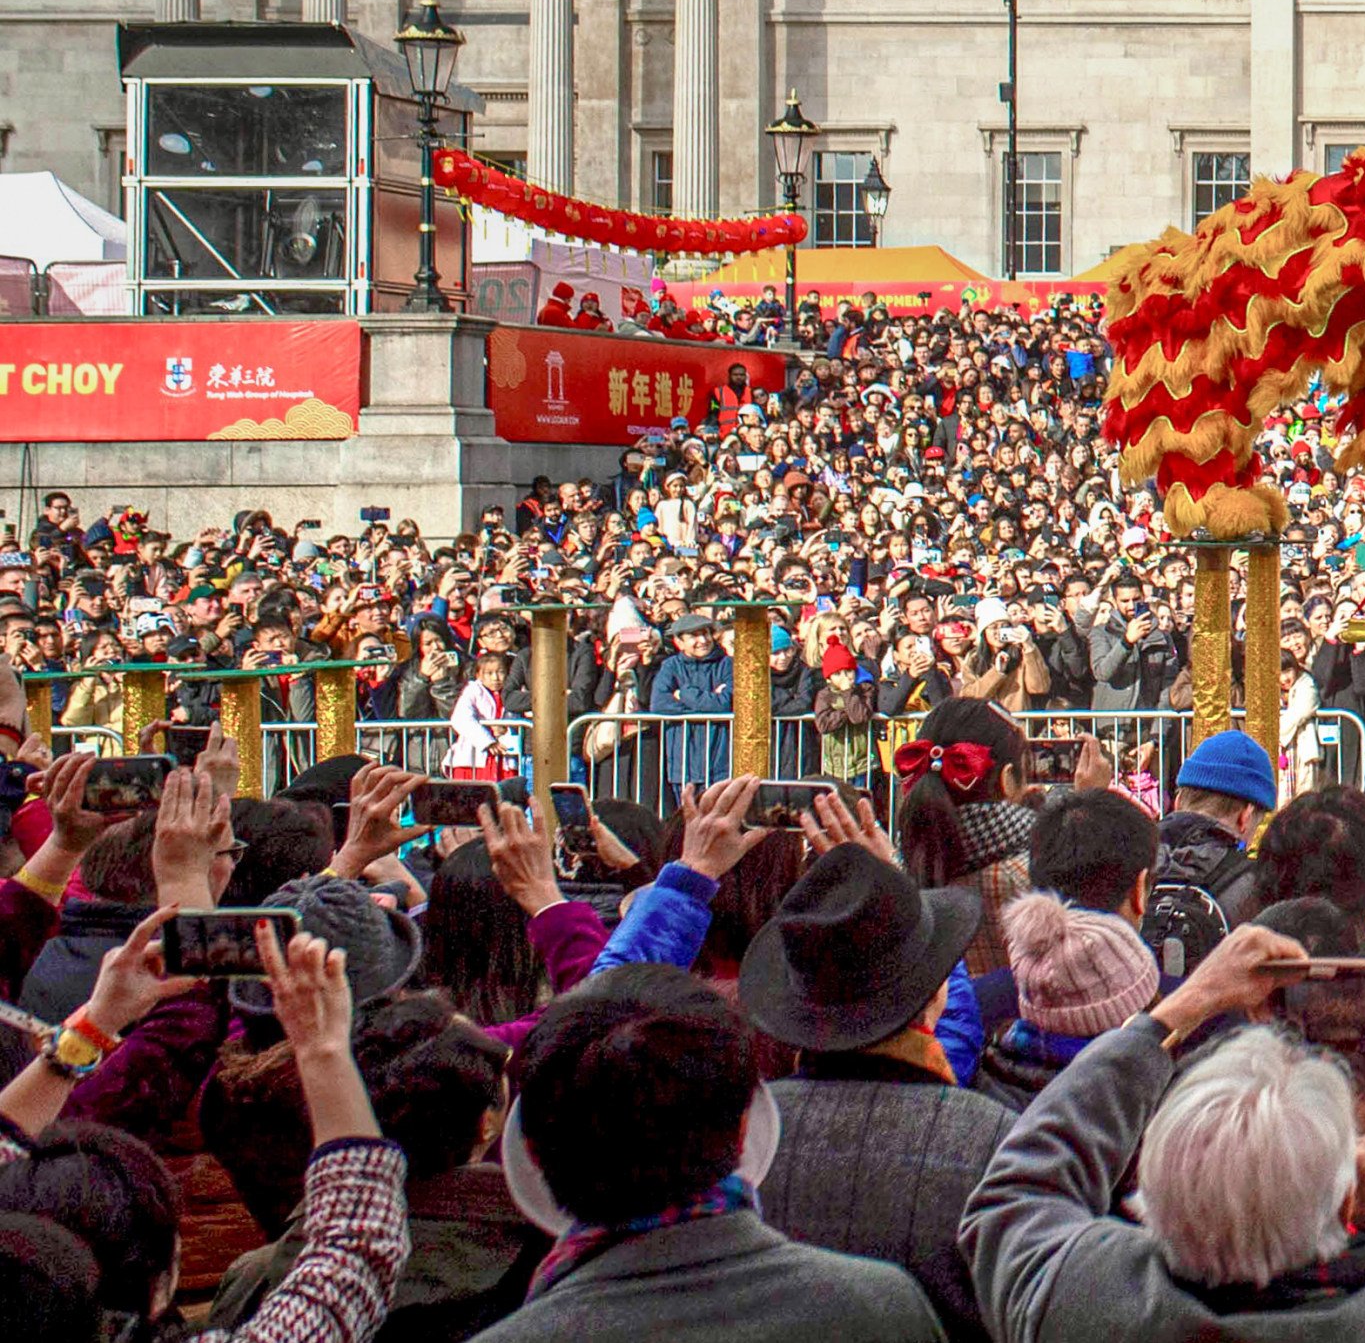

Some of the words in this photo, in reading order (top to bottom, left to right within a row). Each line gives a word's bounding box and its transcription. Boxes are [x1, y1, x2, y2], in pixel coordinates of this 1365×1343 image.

[837, 295, 929, 307] DEVOPMENT
[22, 363, 124, 396] CHOY
[608, 367, 694, 417] 新年進步
